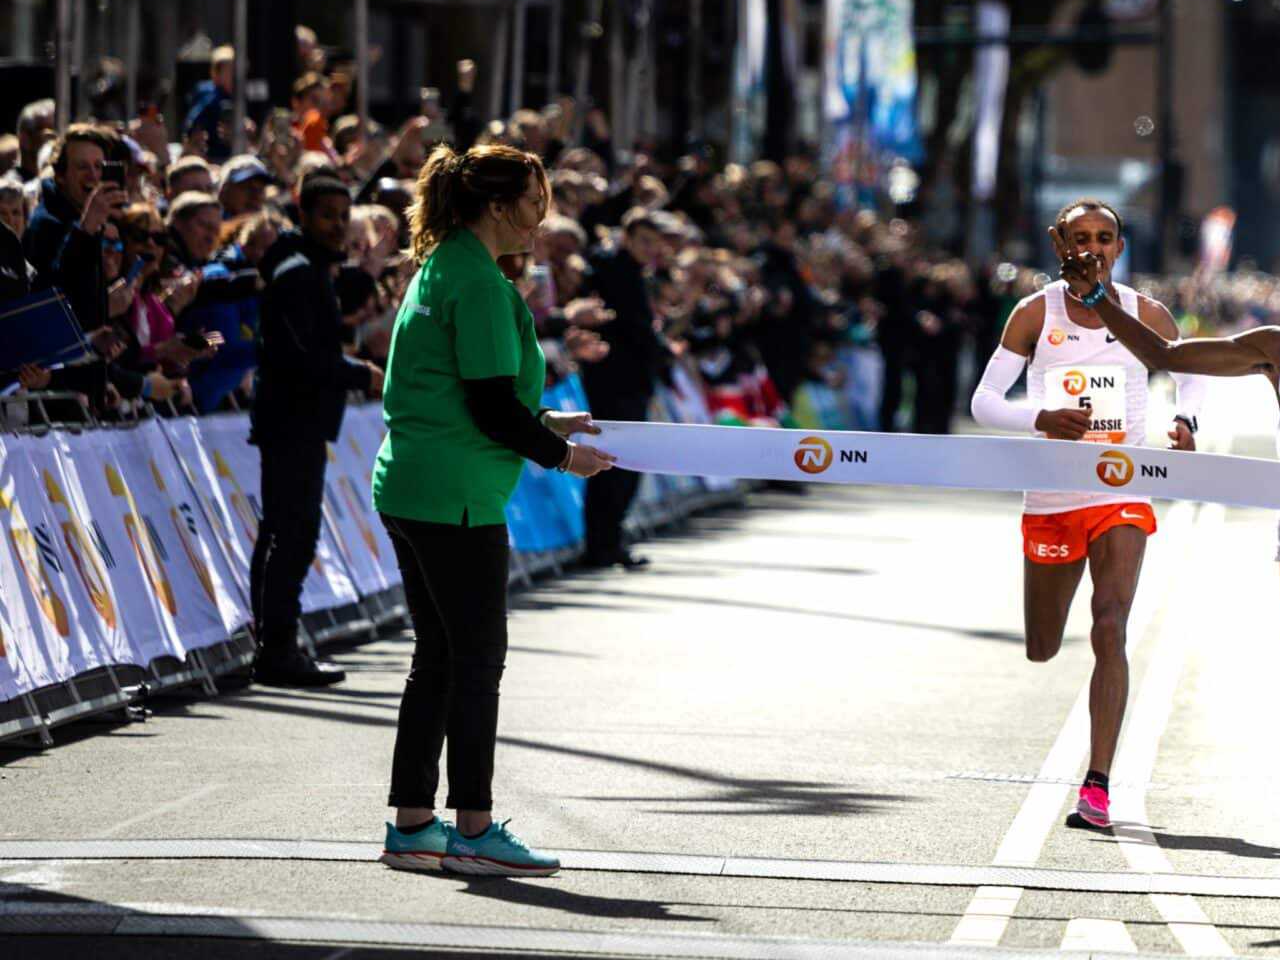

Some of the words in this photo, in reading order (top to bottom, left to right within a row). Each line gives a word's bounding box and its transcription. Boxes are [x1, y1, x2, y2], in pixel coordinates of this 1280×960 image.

[1090, 377, 1114, 388] NN
[1079, 397, 1092, 409] 5
[840, 450, 867, 463] NN
[1141, 464, 1167, 478] NN
